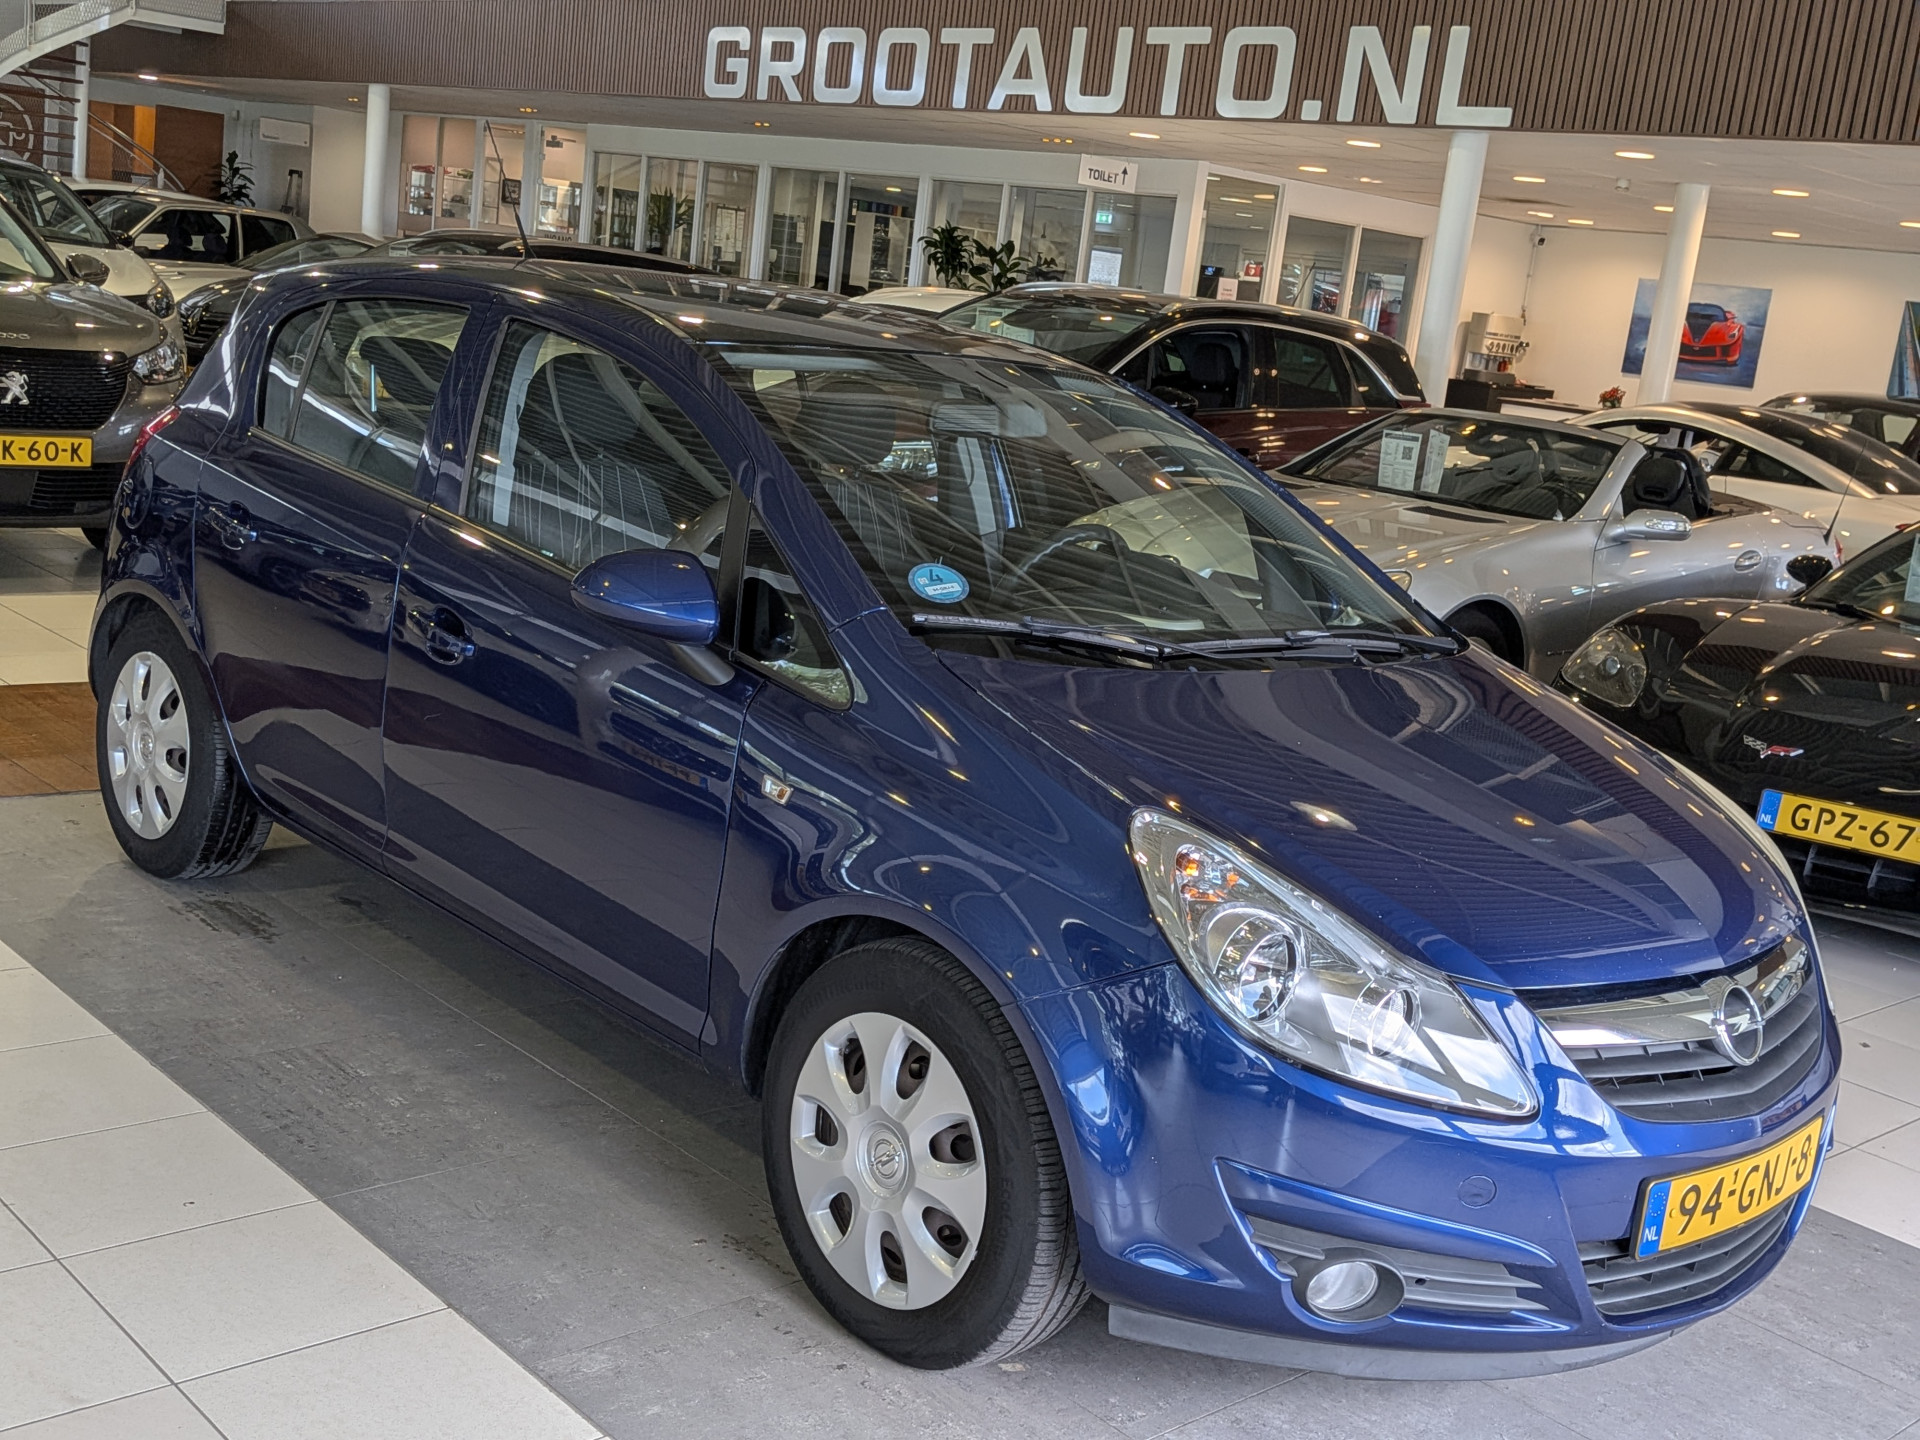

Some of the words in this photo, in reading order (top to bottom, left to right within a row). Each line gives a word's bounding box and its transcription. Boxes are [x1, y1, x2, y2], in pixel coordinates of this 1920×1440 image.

[704, 25, 1514, 126] GROOTAUTO.NL
[1088, 167, 1119, 184] TOILET
[1760, 813, 1774, 825] NL
[1791, 803, 1917, 852] GPZ-67
[1643, 1226, 1659, 1243] NL
[1677, 1133, 1812, 1236] 94-GNJ-8
